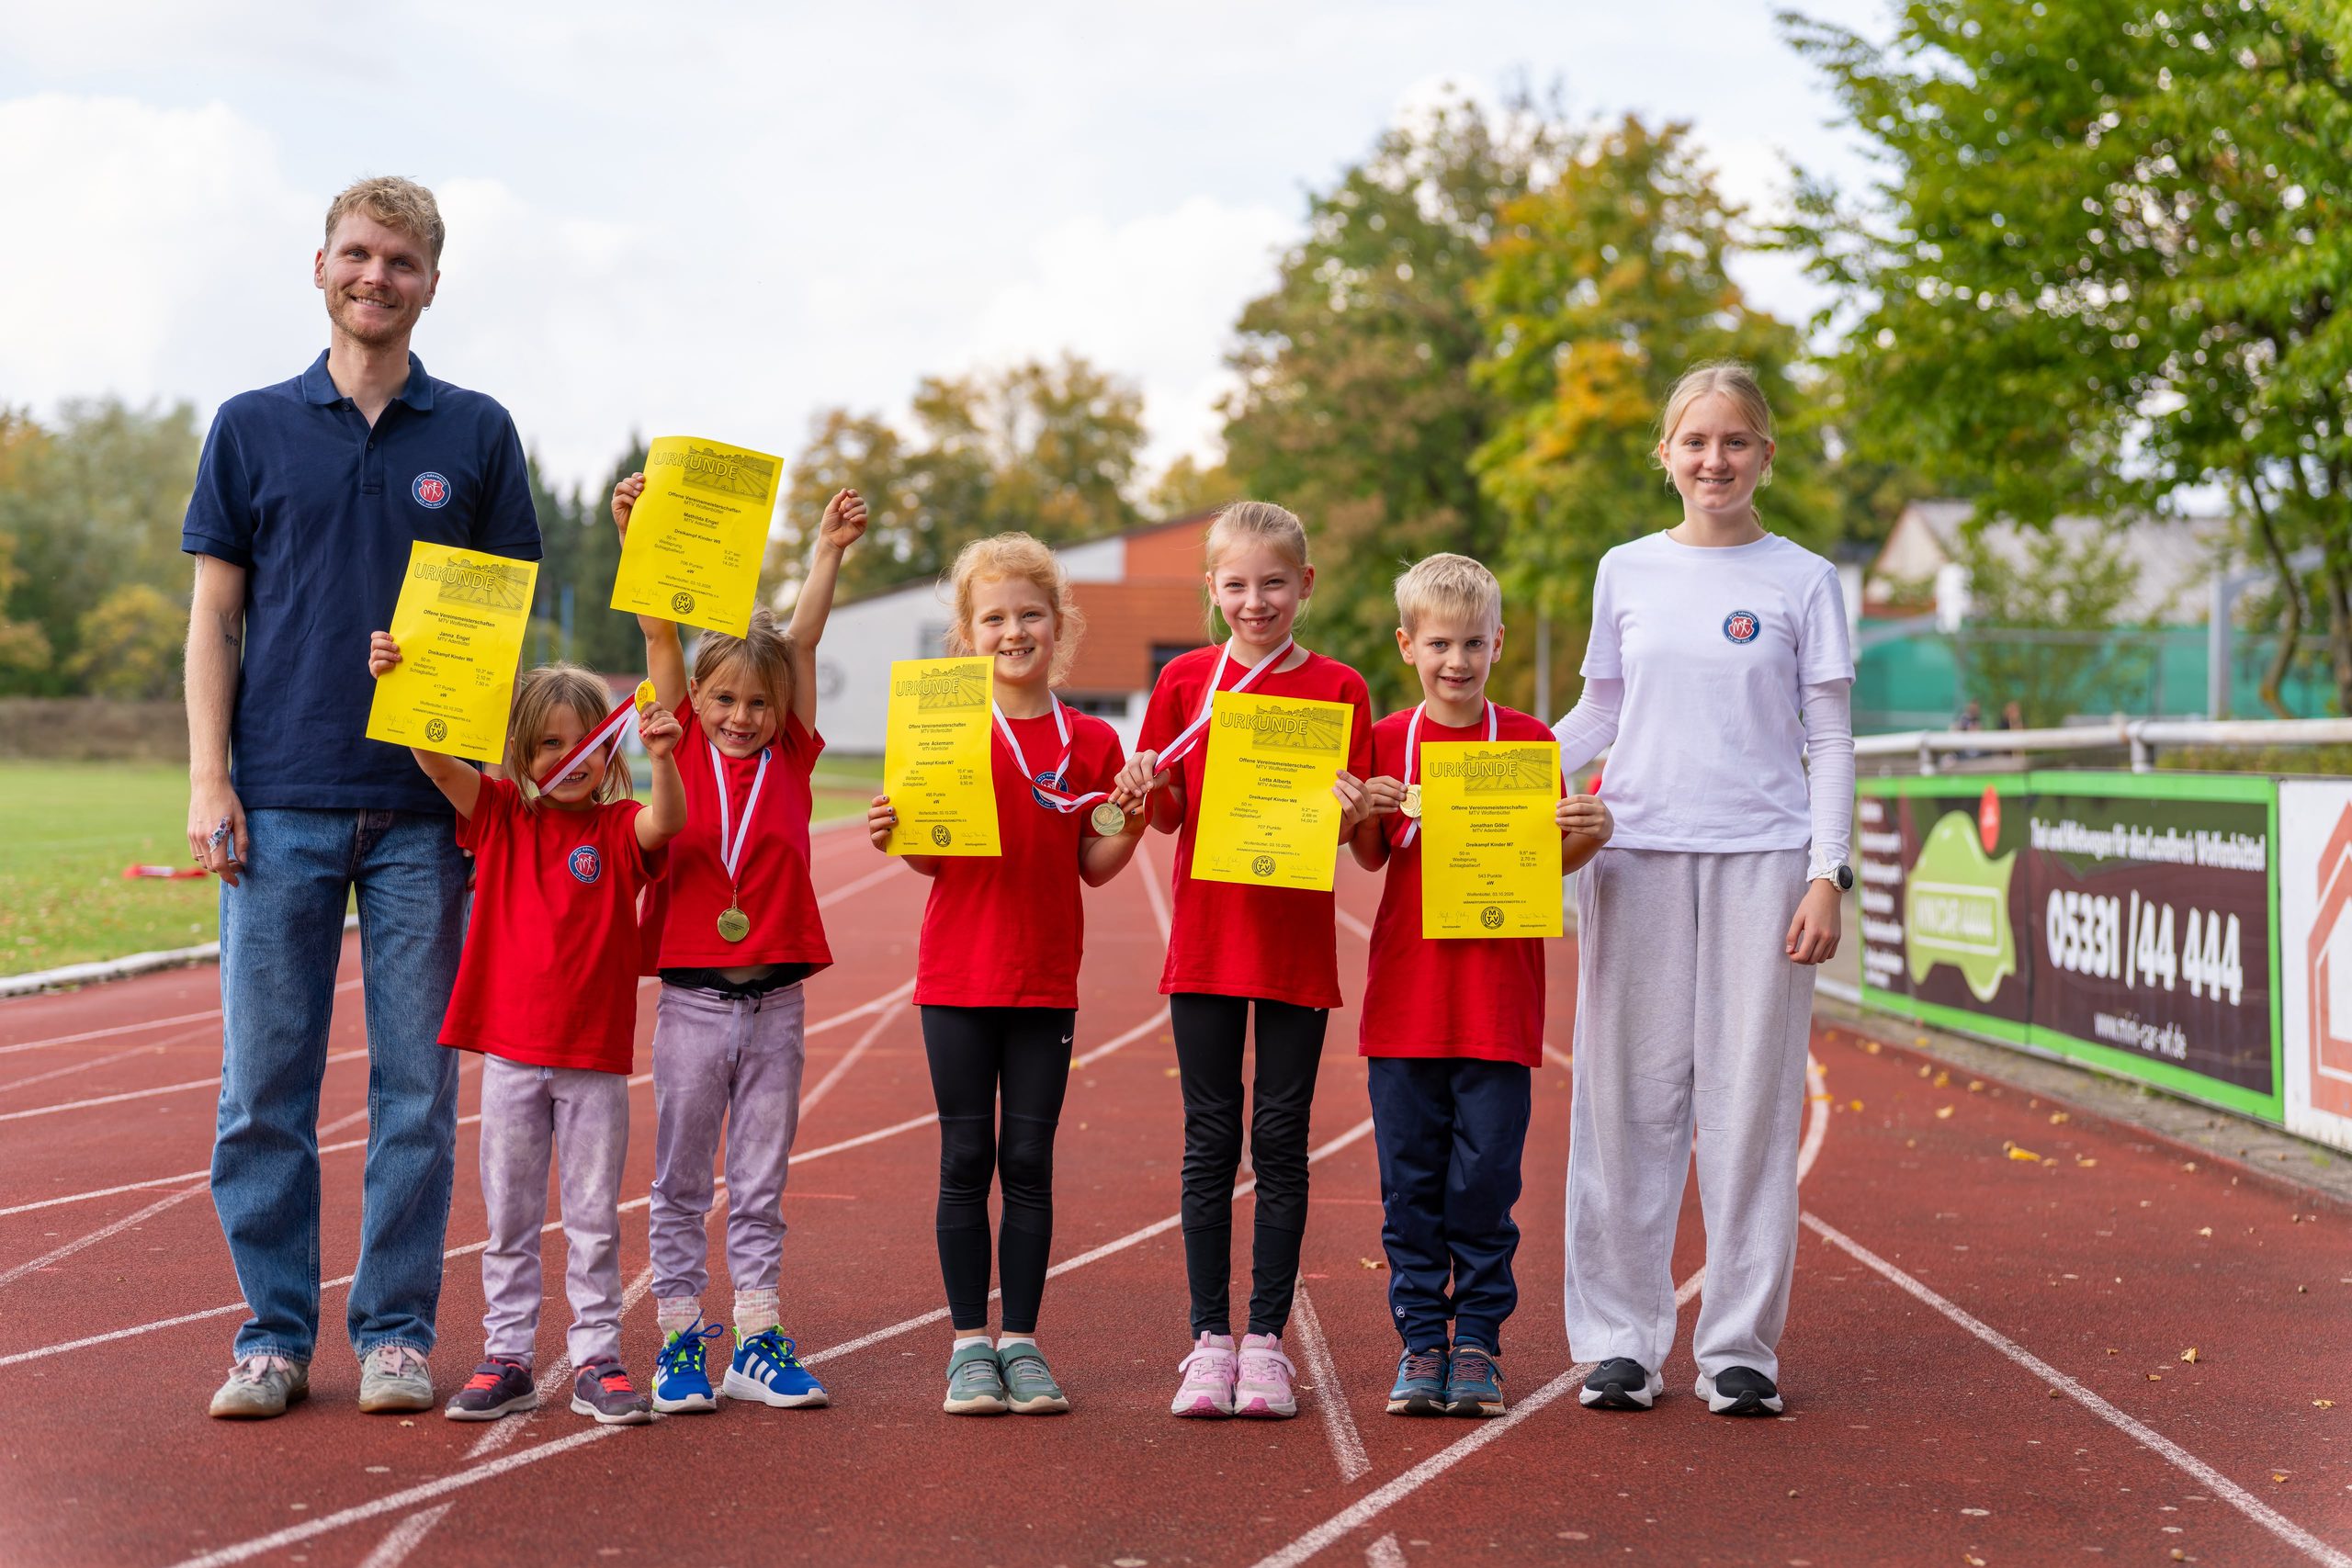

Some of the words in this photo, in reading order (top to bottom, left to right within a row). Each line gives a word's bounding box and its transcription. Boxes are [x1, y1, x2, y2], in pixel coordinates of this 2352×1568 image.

[654, 451, 740, 479] URKUNDE
[684, 495, 741, 513] Vereinsmeisterschaften
[684, 512, 704, 522] Mathilda
[705, 517, 718, 525] Engel
[674, 528, 697, 538] Dreikampf
[414, 563, 496, 592] URKUNDE
[439, 612, 495, 627] Vereinsmeisterschaften
[427, 649, 449, 658] Dreikampf
[895, 678, 960, 696] URKUNDE
[1220, 712, 1308, 735] URKUNDE
[1256, 759, 1315, 769] Vereinsmeisterschaften
[1430, 761, 1518, 777] URKUNDE
[2196, 830, 2266, 872] Wolfenbüttel
[2046, 888, 2120, 979] 05331
[2182, 907, 2243, 1006] 444
